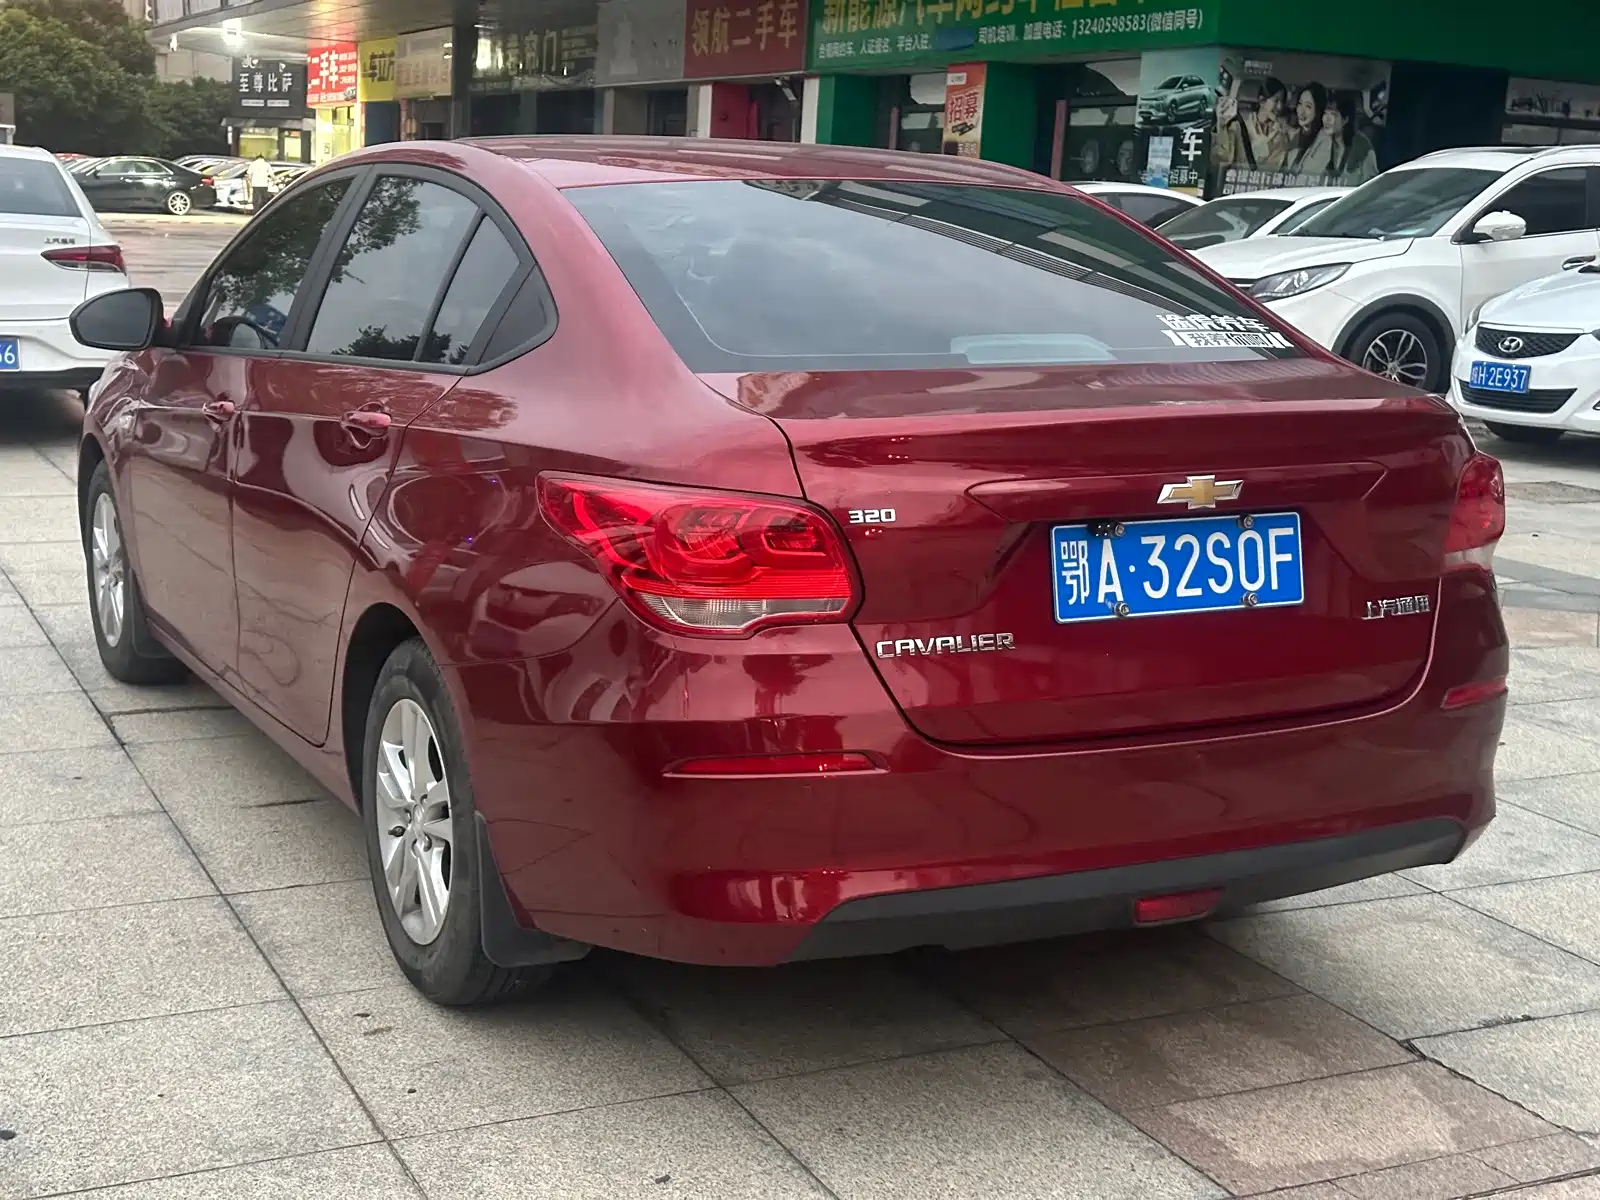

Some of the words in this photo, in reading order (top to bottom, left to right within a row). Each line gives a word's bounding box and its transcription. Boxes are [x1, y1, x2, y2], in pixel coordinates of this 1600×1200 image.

[691, 0, 797, 57] 领航二手车
[239, 72, 293, 93] 至尊比萨
[948, 91, 980, 123] 招募
[0, 344, 15, 364] 6
[848, 508, 897, 524] 320
[1361, 594, 1431, 620] 上汽通用
[876, 632, 1016, 659] CAVALIER
